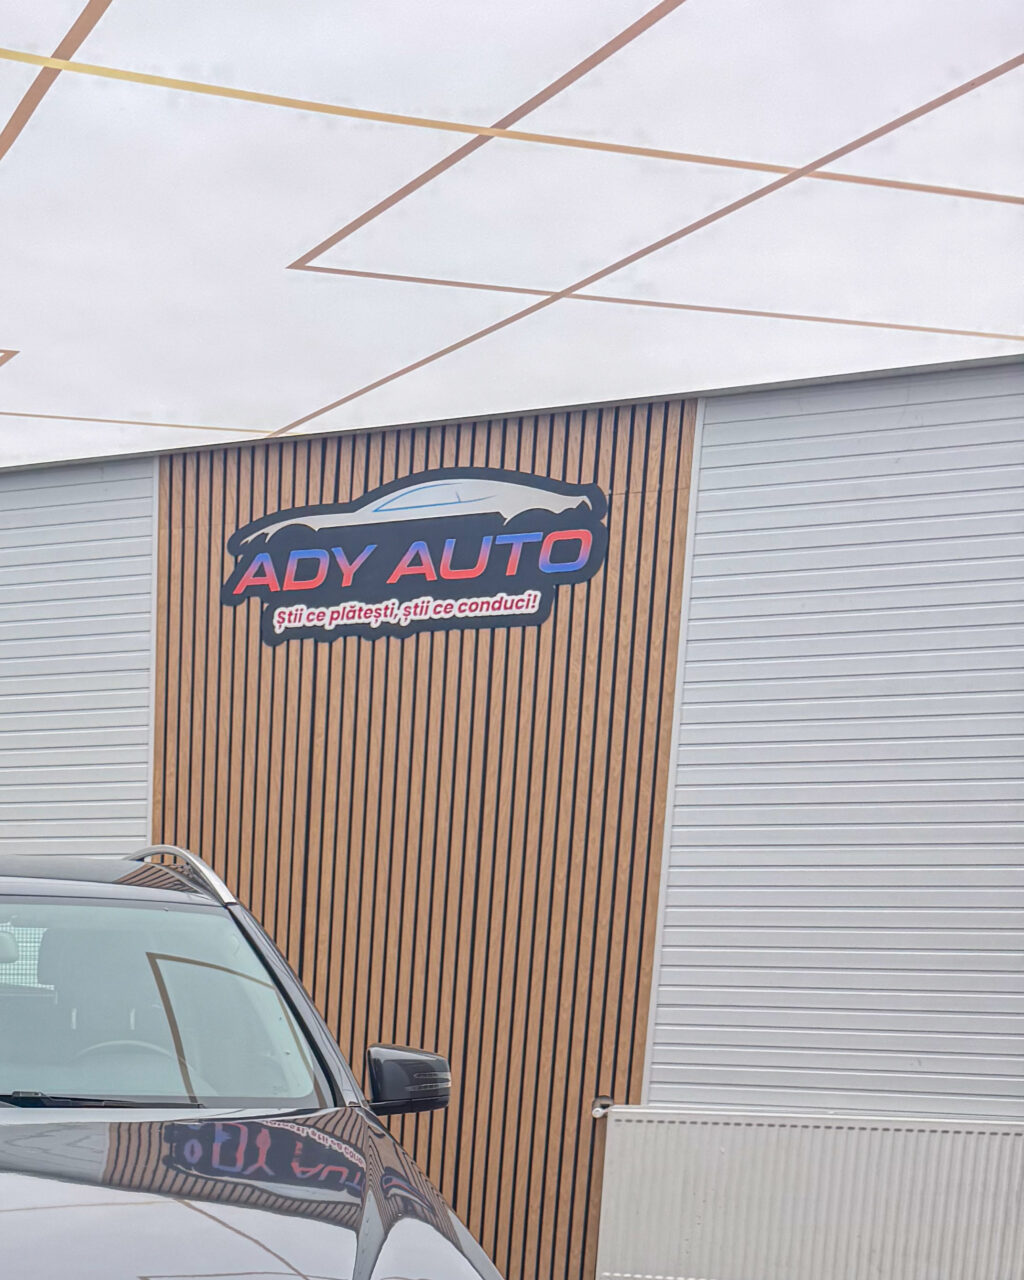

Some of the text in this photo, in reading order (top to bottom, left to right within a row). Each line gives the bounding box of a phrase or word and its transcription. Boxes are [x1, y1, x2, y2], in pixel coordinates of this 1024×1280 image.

[232, 529, 593, 595] ADY AUTO
[276, 593, 538, 630] Știi ce plătești, știi ce conduci!
